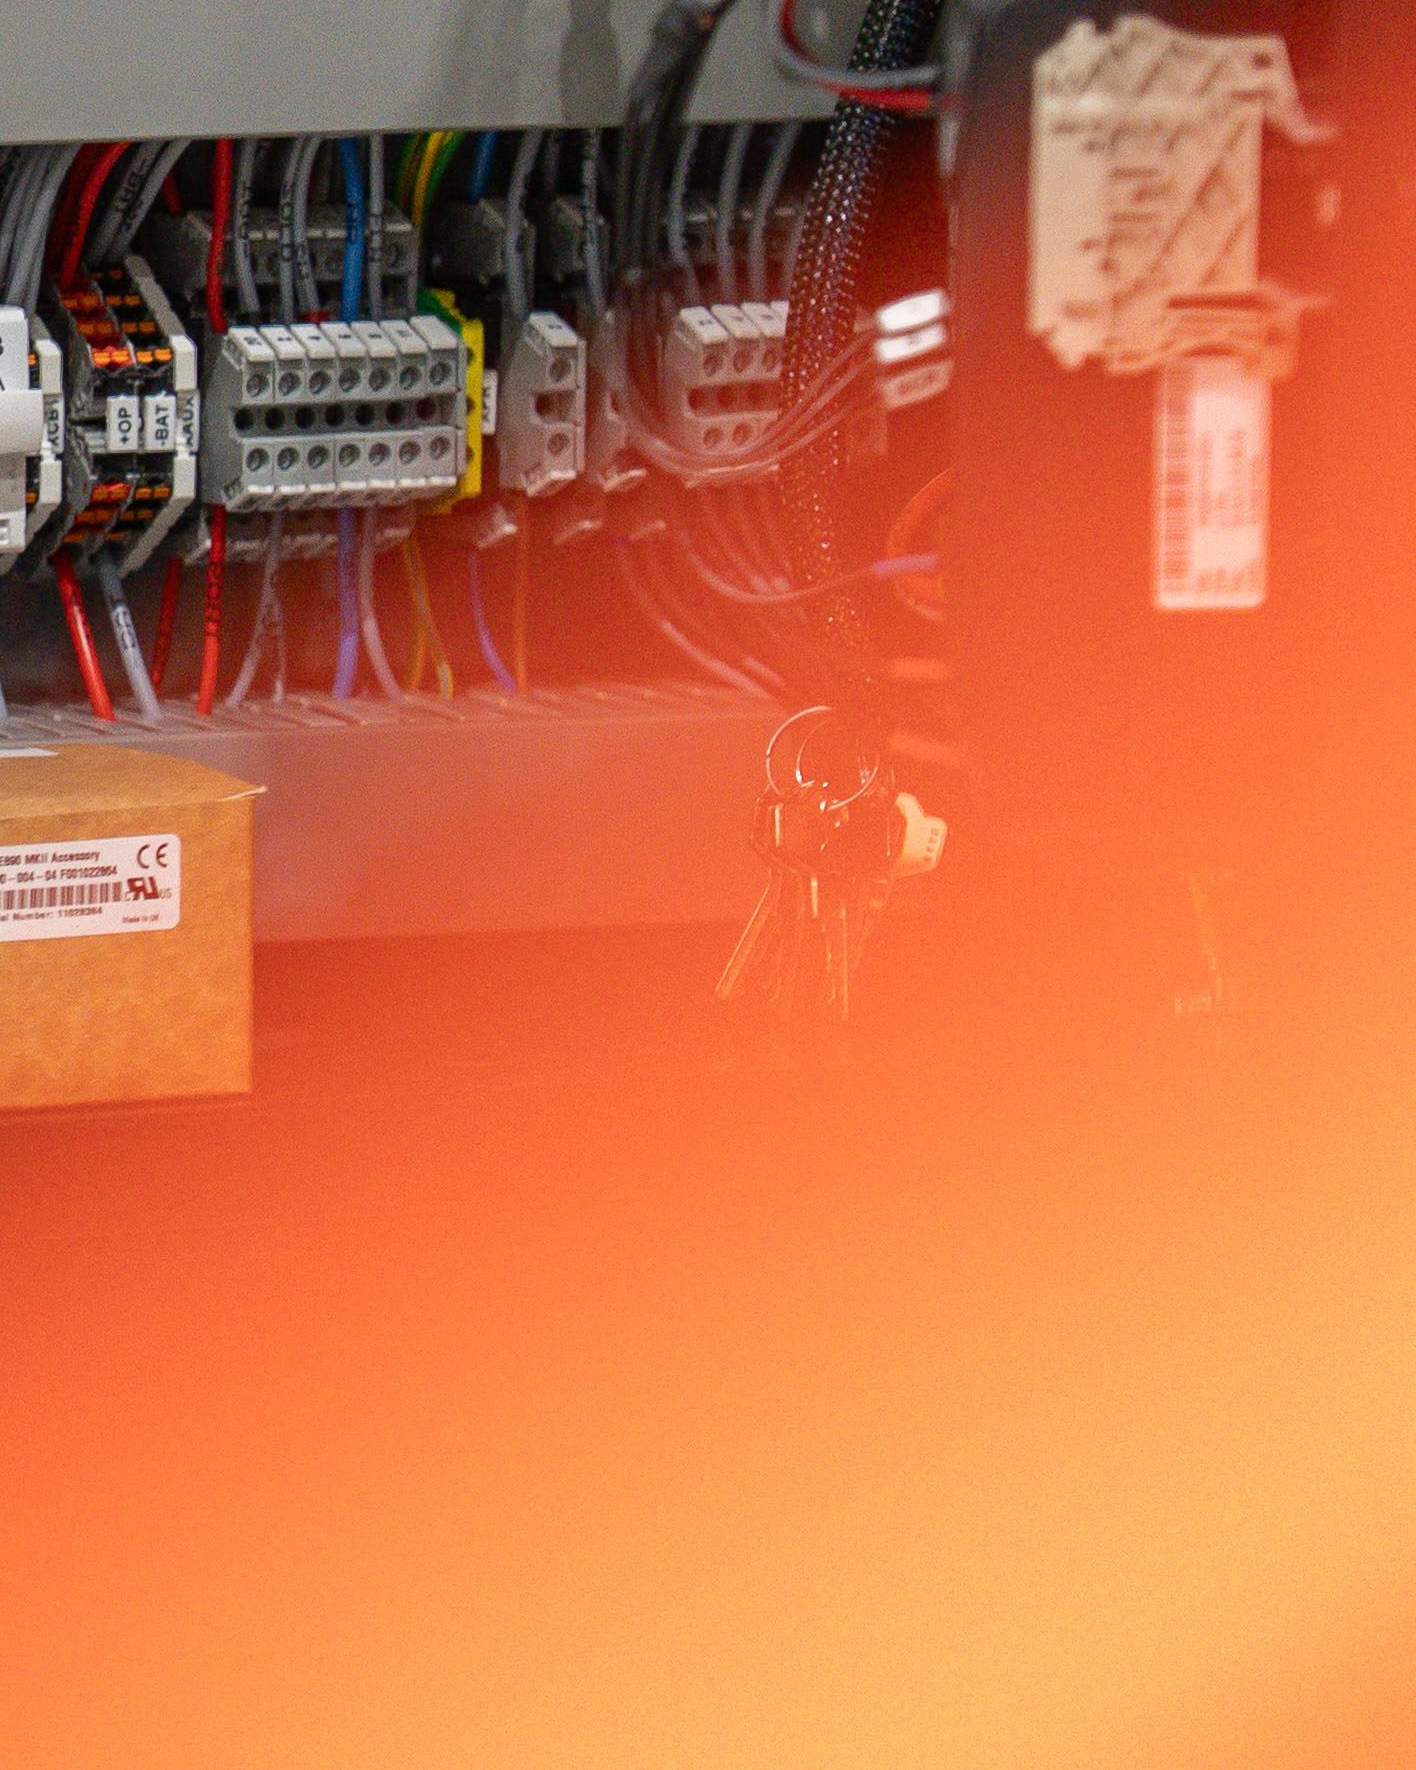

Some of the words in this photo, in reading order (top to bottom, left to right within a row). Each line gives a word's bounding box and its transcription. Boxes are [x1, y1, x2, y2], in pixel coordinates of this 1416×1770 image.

[118, 407, 134, 443] +OP
[153, 404, 170, 446] -BAT
[25, 853, 48, 865] MKII
[51, 851, 100, 864] Accessory
[45, 868, 57, 880] 04
[12, 910, 53, 921] Number:
